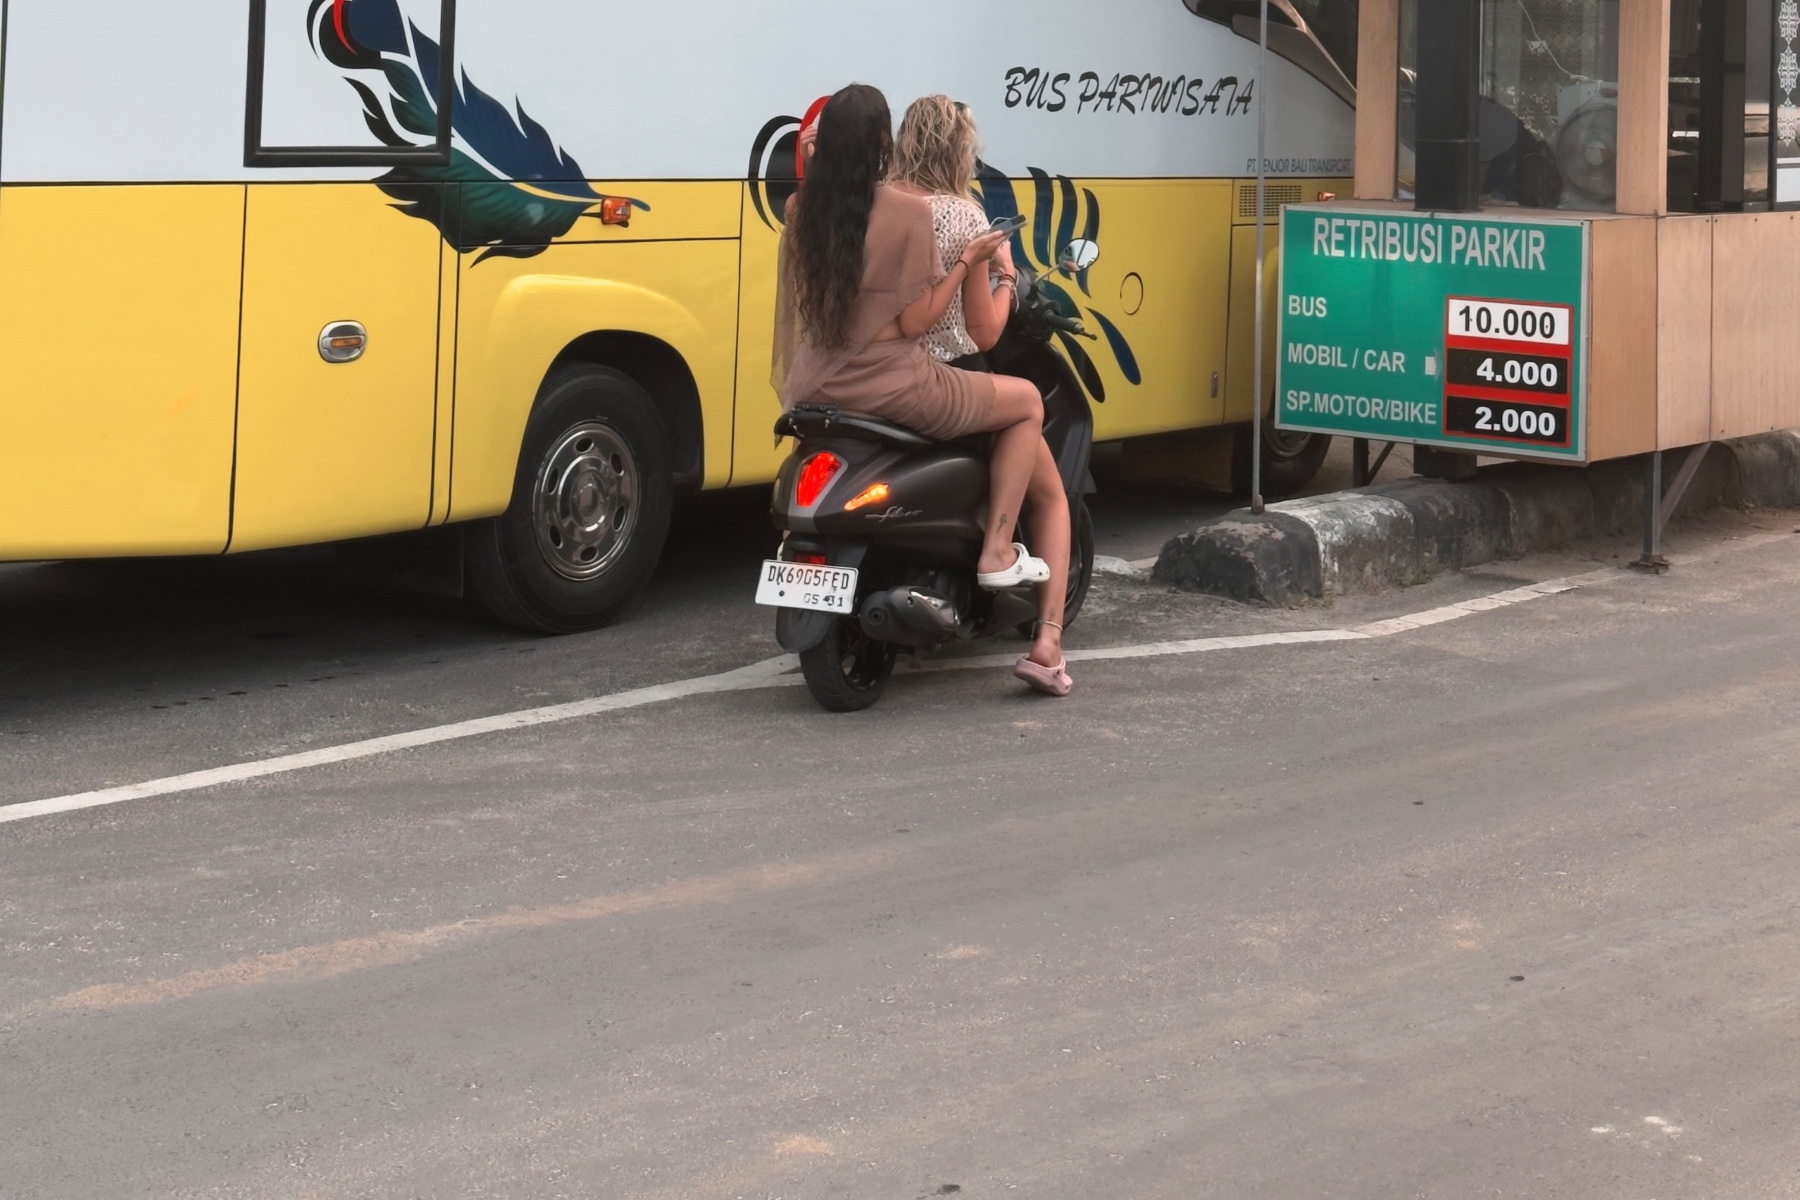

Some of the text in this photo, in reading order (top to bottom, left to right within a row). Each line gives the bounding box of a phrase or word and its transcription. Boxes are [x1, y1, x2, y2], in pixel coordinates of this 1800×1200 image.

[1004, 66, 1255, 117] BUS PARIWISATA
[1313, 217, 1546, 271] RETRIBUSI PARKIR
[1287, 294, 1327, 318] BUS
[1458, 305, 1556, 339] 10.000
[1287, 342, 1348, 369] MOBIL
[1363, 349, 1406, 374] CAR
[1476, 358, 1558, 388] 4.000
[1474, 406, 1556, 437] 2.000
